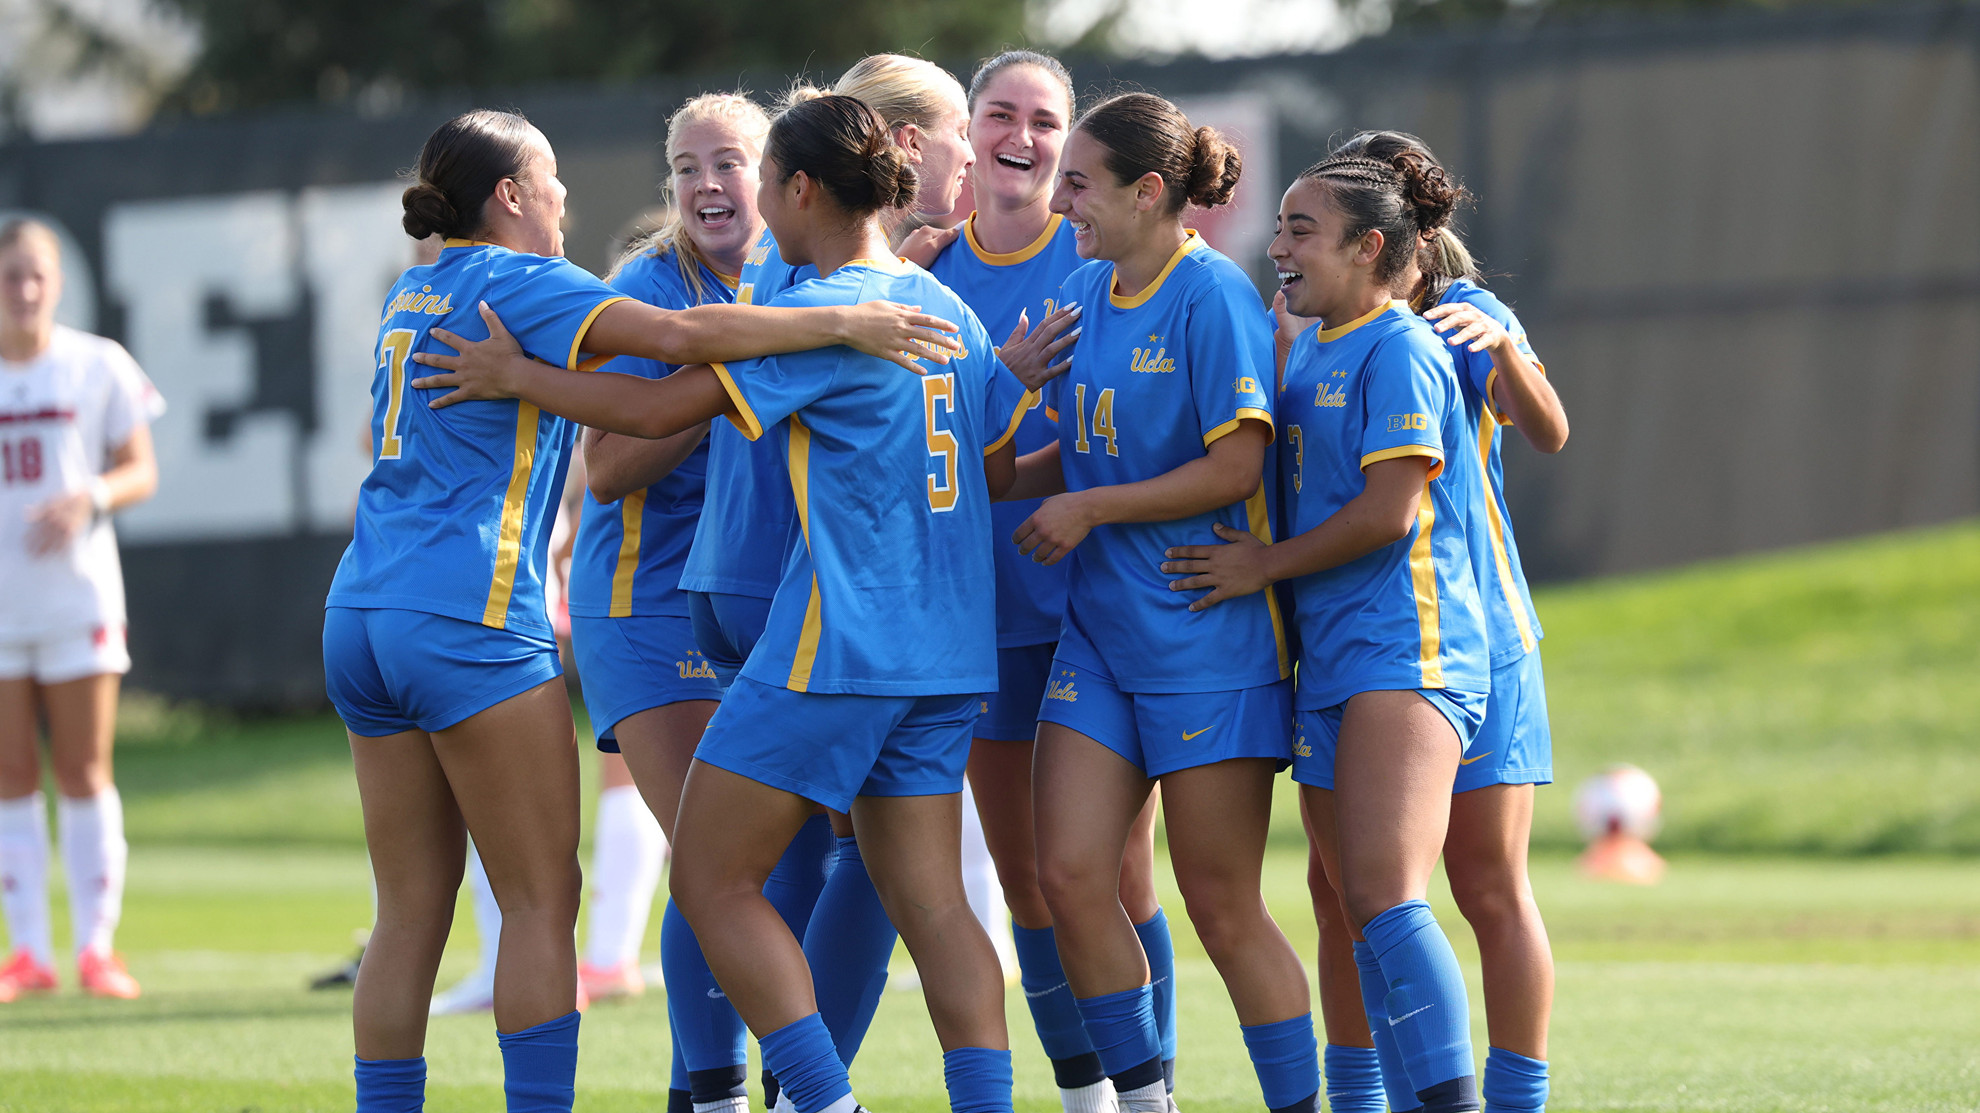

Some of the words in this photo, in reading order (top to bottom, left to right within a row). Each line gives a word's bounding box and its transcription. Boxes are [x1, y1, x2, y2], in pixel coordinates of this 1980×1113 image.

[1130, 347, 1176, 373] Ucla
[379, 328, 417, 460] 7
[1075, 383, 1119, 457] 14
[1314, 382, 1347, 408] Ucla
[3, 435, 43, 485] 18
[921, 372, 959, 513] 5
[1287, 424, 1304, 494] 3
[1047, 680, 1079, 702] Ucla
